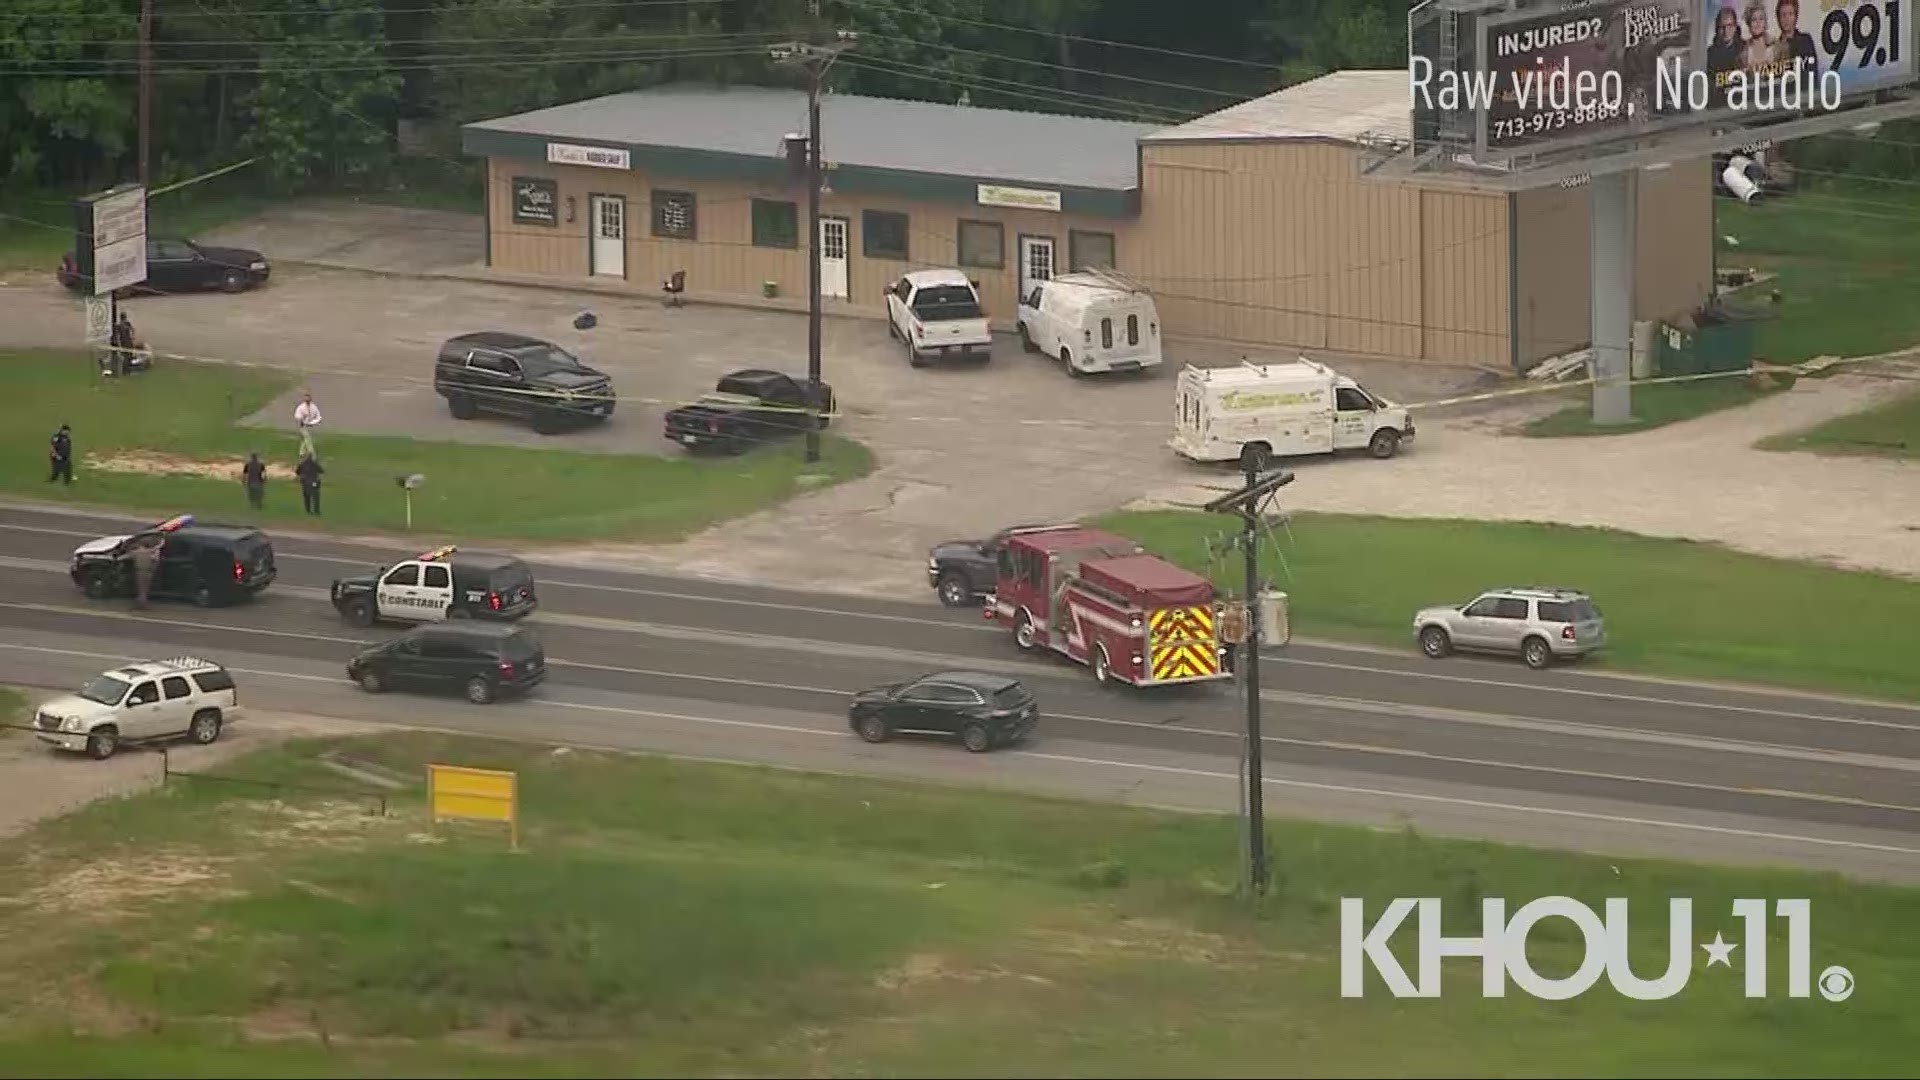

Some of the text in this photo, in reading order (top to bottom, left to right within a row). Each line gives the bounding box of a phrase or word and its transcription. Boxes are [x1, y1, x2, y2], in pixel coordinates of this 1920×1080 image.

[1498, 18, 1601, 56] INJURED?
[1821, 1, 1900, 73] 99.1
[1494, 99, 1620, 139] 713-973-8888
[388, 595, 446, 609] CONSTABLE
